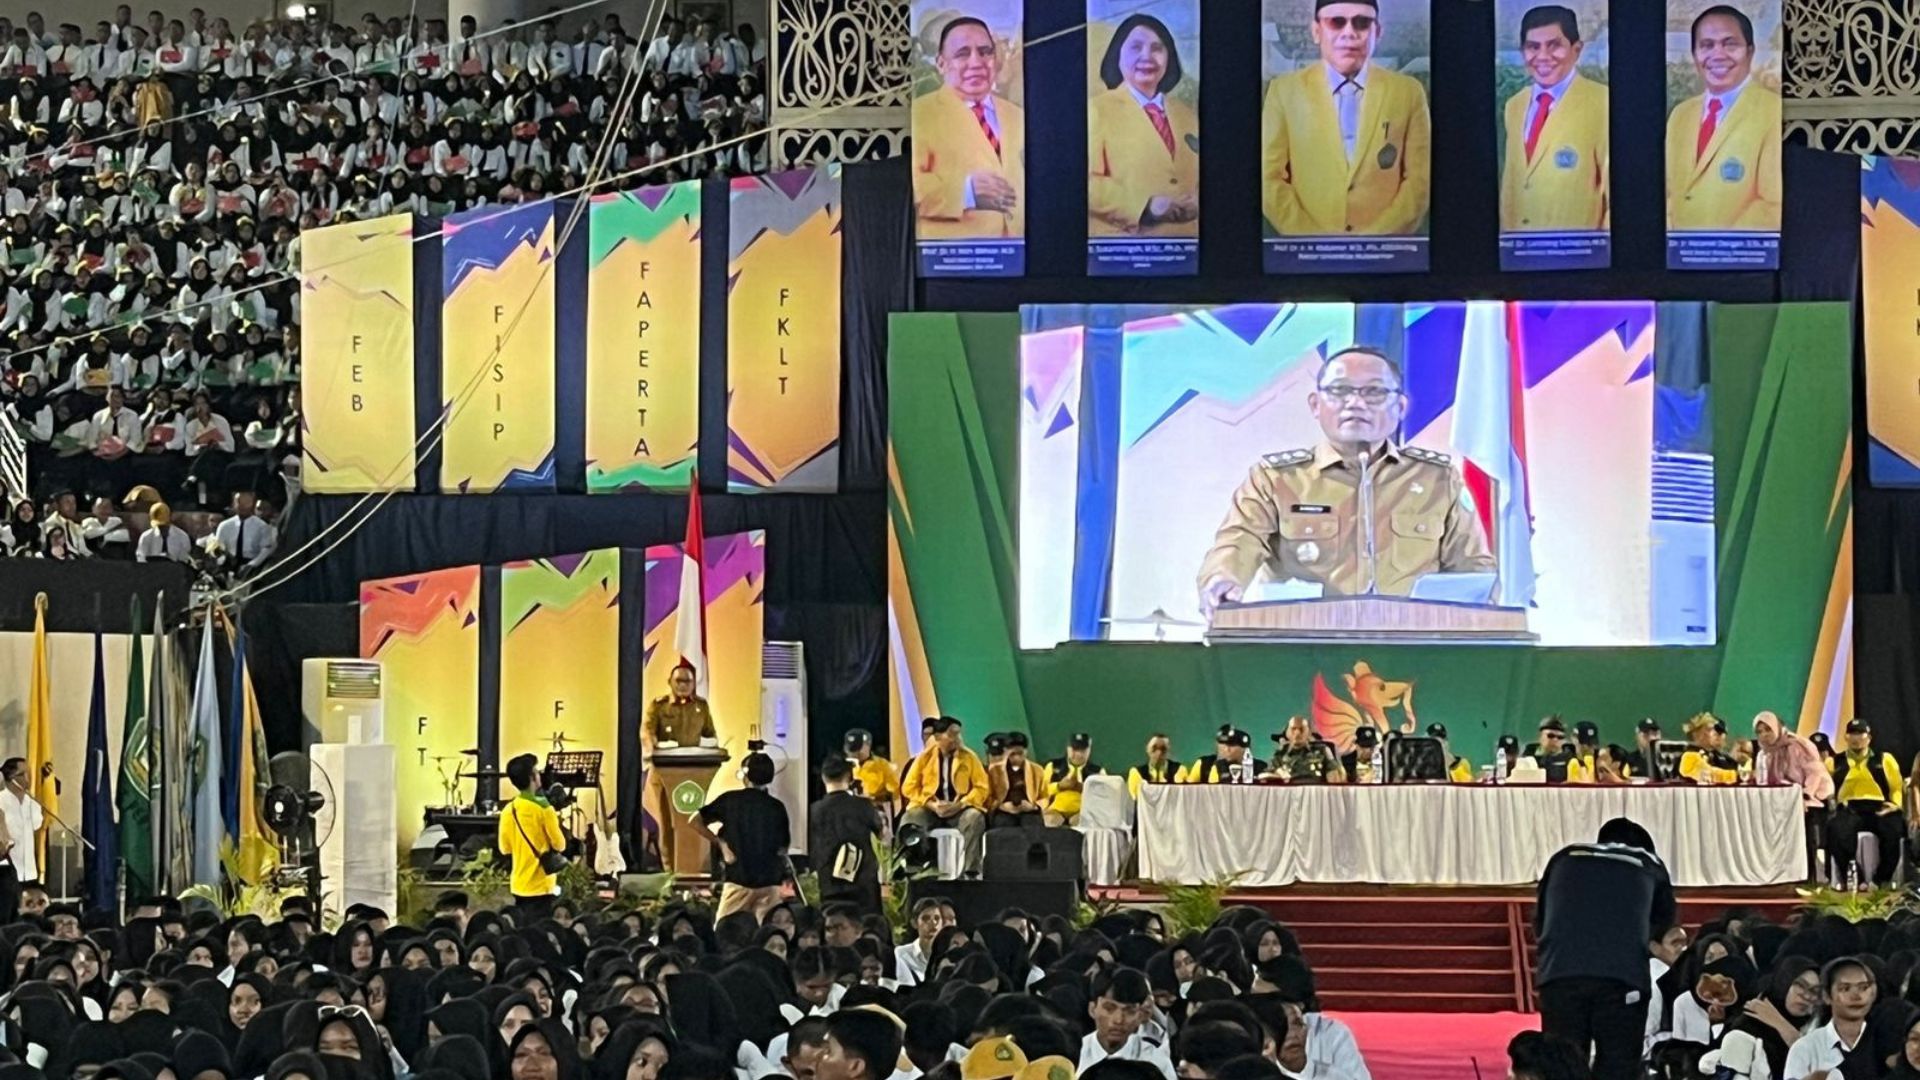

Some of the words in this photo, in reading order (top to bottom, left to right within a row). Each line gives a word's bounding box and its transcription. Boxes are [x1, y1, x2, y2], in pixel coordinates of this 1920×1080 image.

[351, 335, 364, 412] FEB
[492, 305, 505, 440] FISIP
[633, 261, 652, 457] FAPERTA
[777, 288, 790, 395] FKLT
[417, 716, 428, 766] FT
